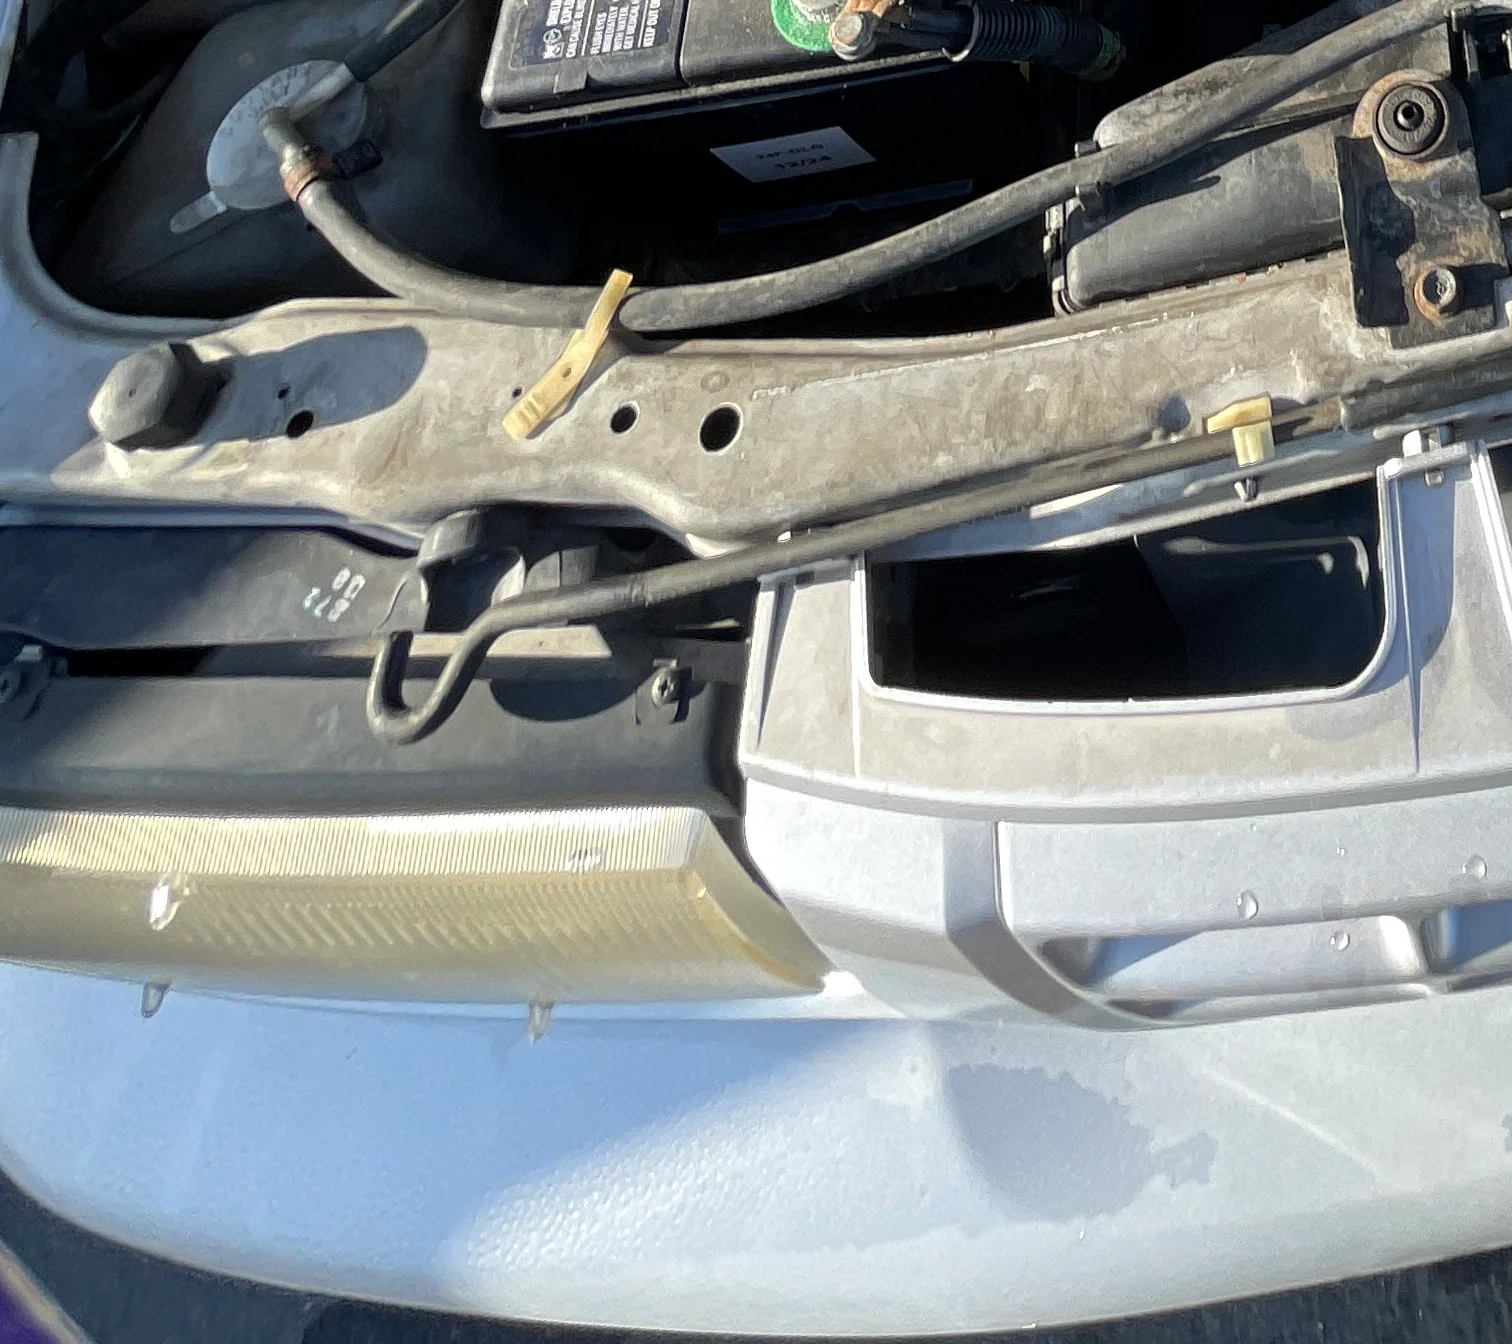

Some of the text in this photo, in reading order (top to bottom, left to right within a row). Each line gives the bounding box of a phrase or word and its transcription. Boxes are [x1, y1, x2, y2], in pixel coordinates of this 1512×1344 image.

[647, 10, 658, 26] OUT
[643, 25, 655, 46] KEEP
[566, 42, 577, 56] CAN
